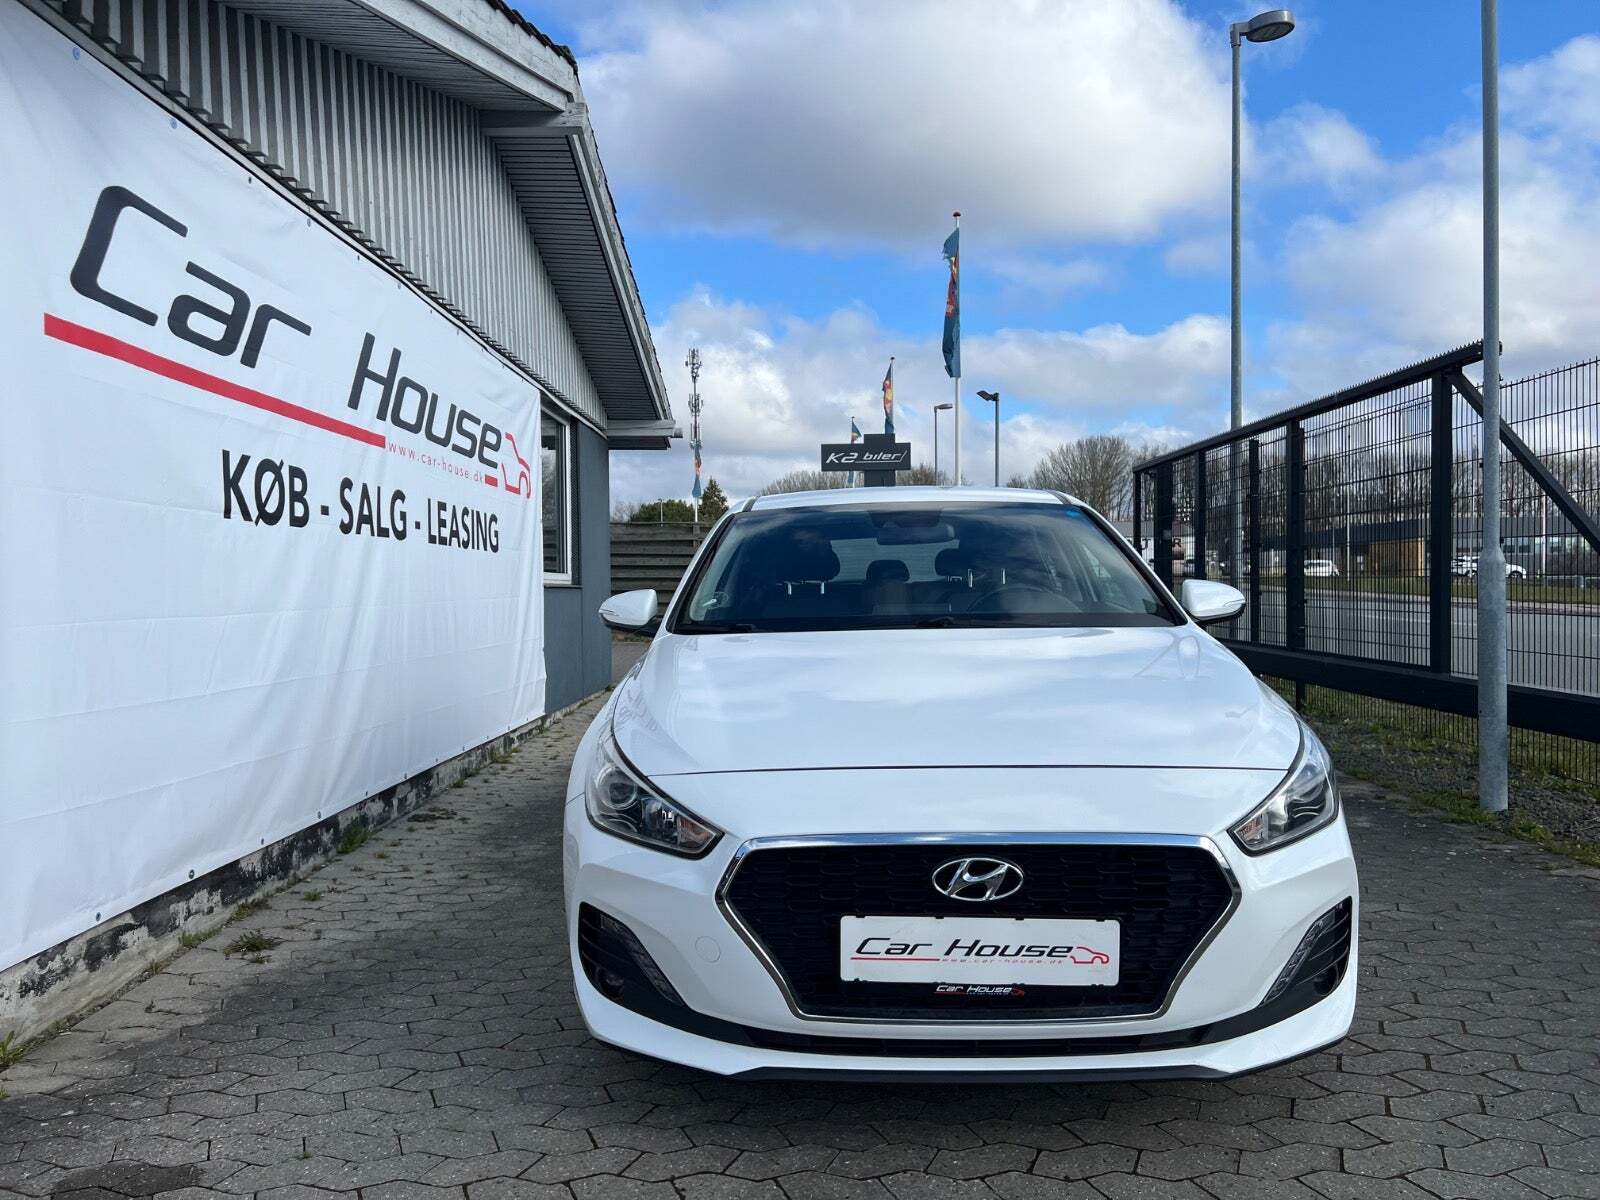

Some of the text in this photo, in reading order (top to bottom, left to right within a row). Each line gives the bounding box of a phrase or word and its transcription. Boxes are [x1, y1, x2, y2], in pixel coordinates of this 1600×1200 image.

[70, 185, 502, 470] Car House
[388, 441, 484, 484] www.car-house.dk
[825, 452, 902, 464] K2 biler
[222, 449, 310, 527] KØB
[339, 477, 407, 541] SALG
[427, 498, 499, 553] LEASING
[855, 937, 1074, 958] Car House
[936, 984, 1012, 993] Car House
